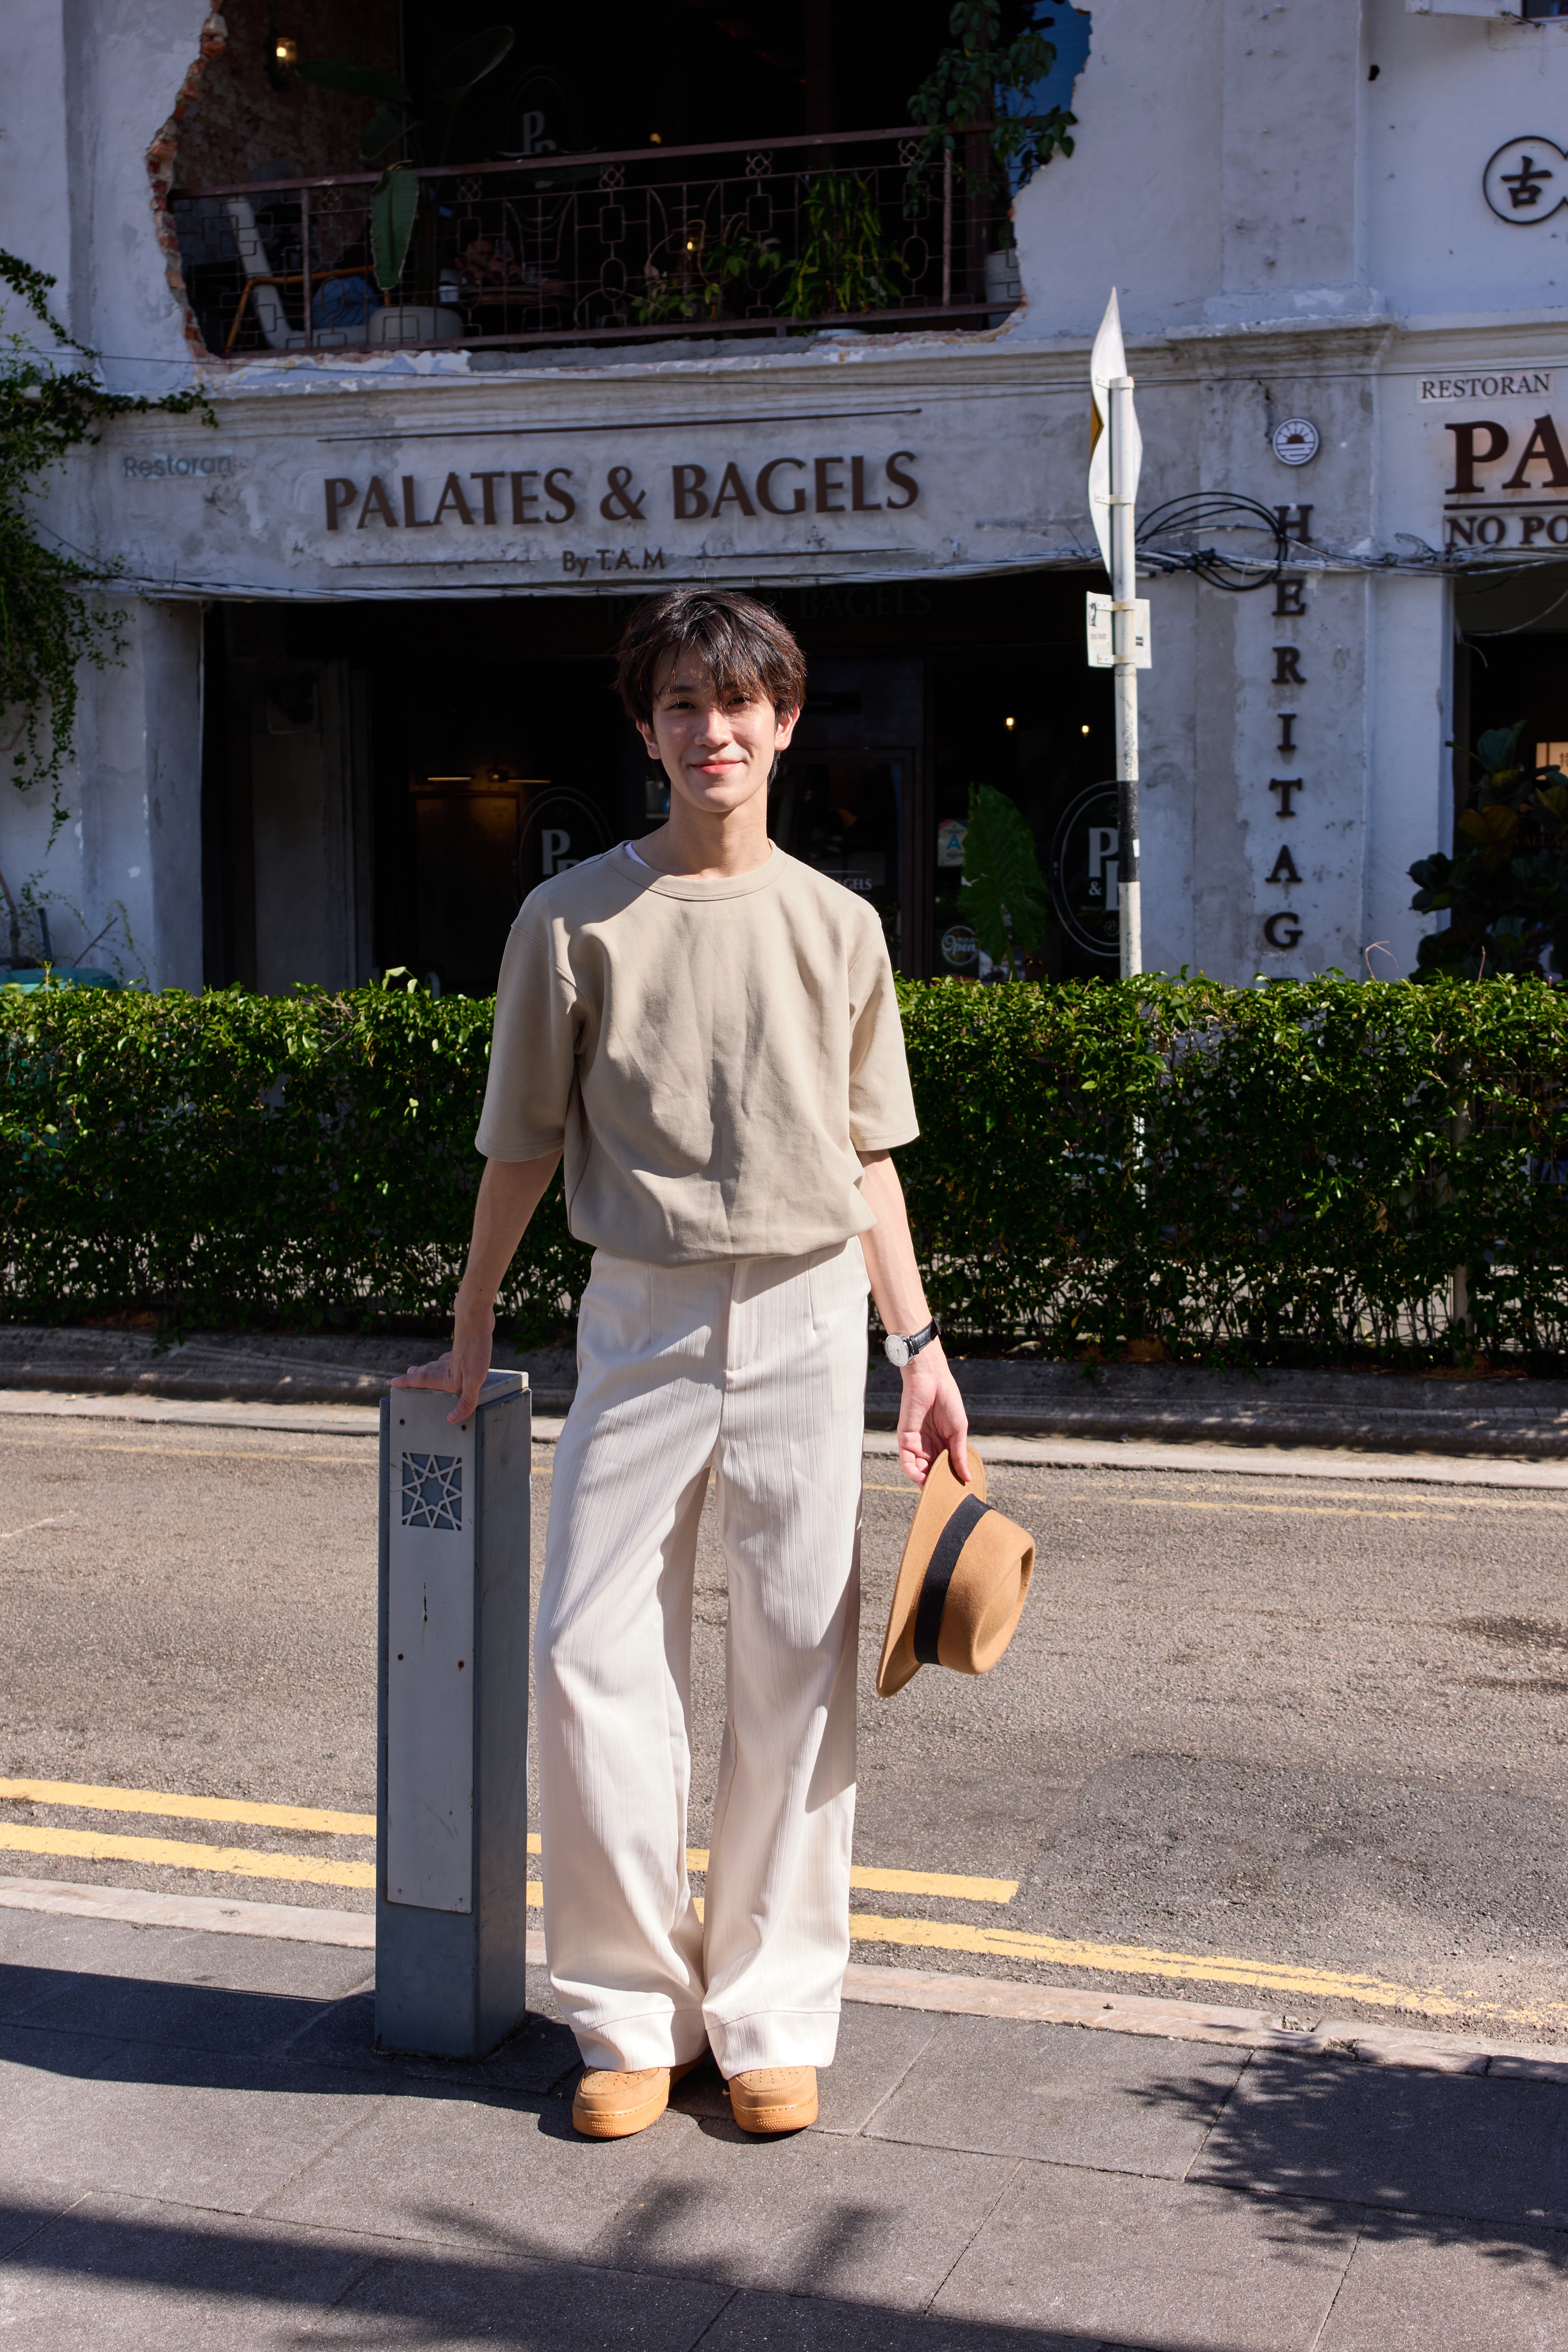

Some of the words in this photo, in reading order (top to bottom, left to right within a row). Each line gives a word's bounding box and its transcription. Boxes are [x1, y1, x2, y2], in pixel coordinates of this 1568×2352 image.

[1500, 155, 1552, 208] 古
[1421, 373, 1550, 398] RESTORAN
[123, 455, 233, 477] Restoran
[1445, 414, 1568, 495] PA
[324, 467, 575, 530] PALATES
[600, 466, 647, 521] &
[671, 450, 919, 519] BAGELS
[1446, 516, 1505, 546] NO
[1519, 515, 1568, 544] PO
[562, 550, 591, 577] By
[800, 583, 932, 619] BAGELS
[1263, 504, 1315, 983] HERITAG
[947, 834, 961, 850] A
[1087, 880, 1103, 897] &
[942, 935, 976, 956] Open
